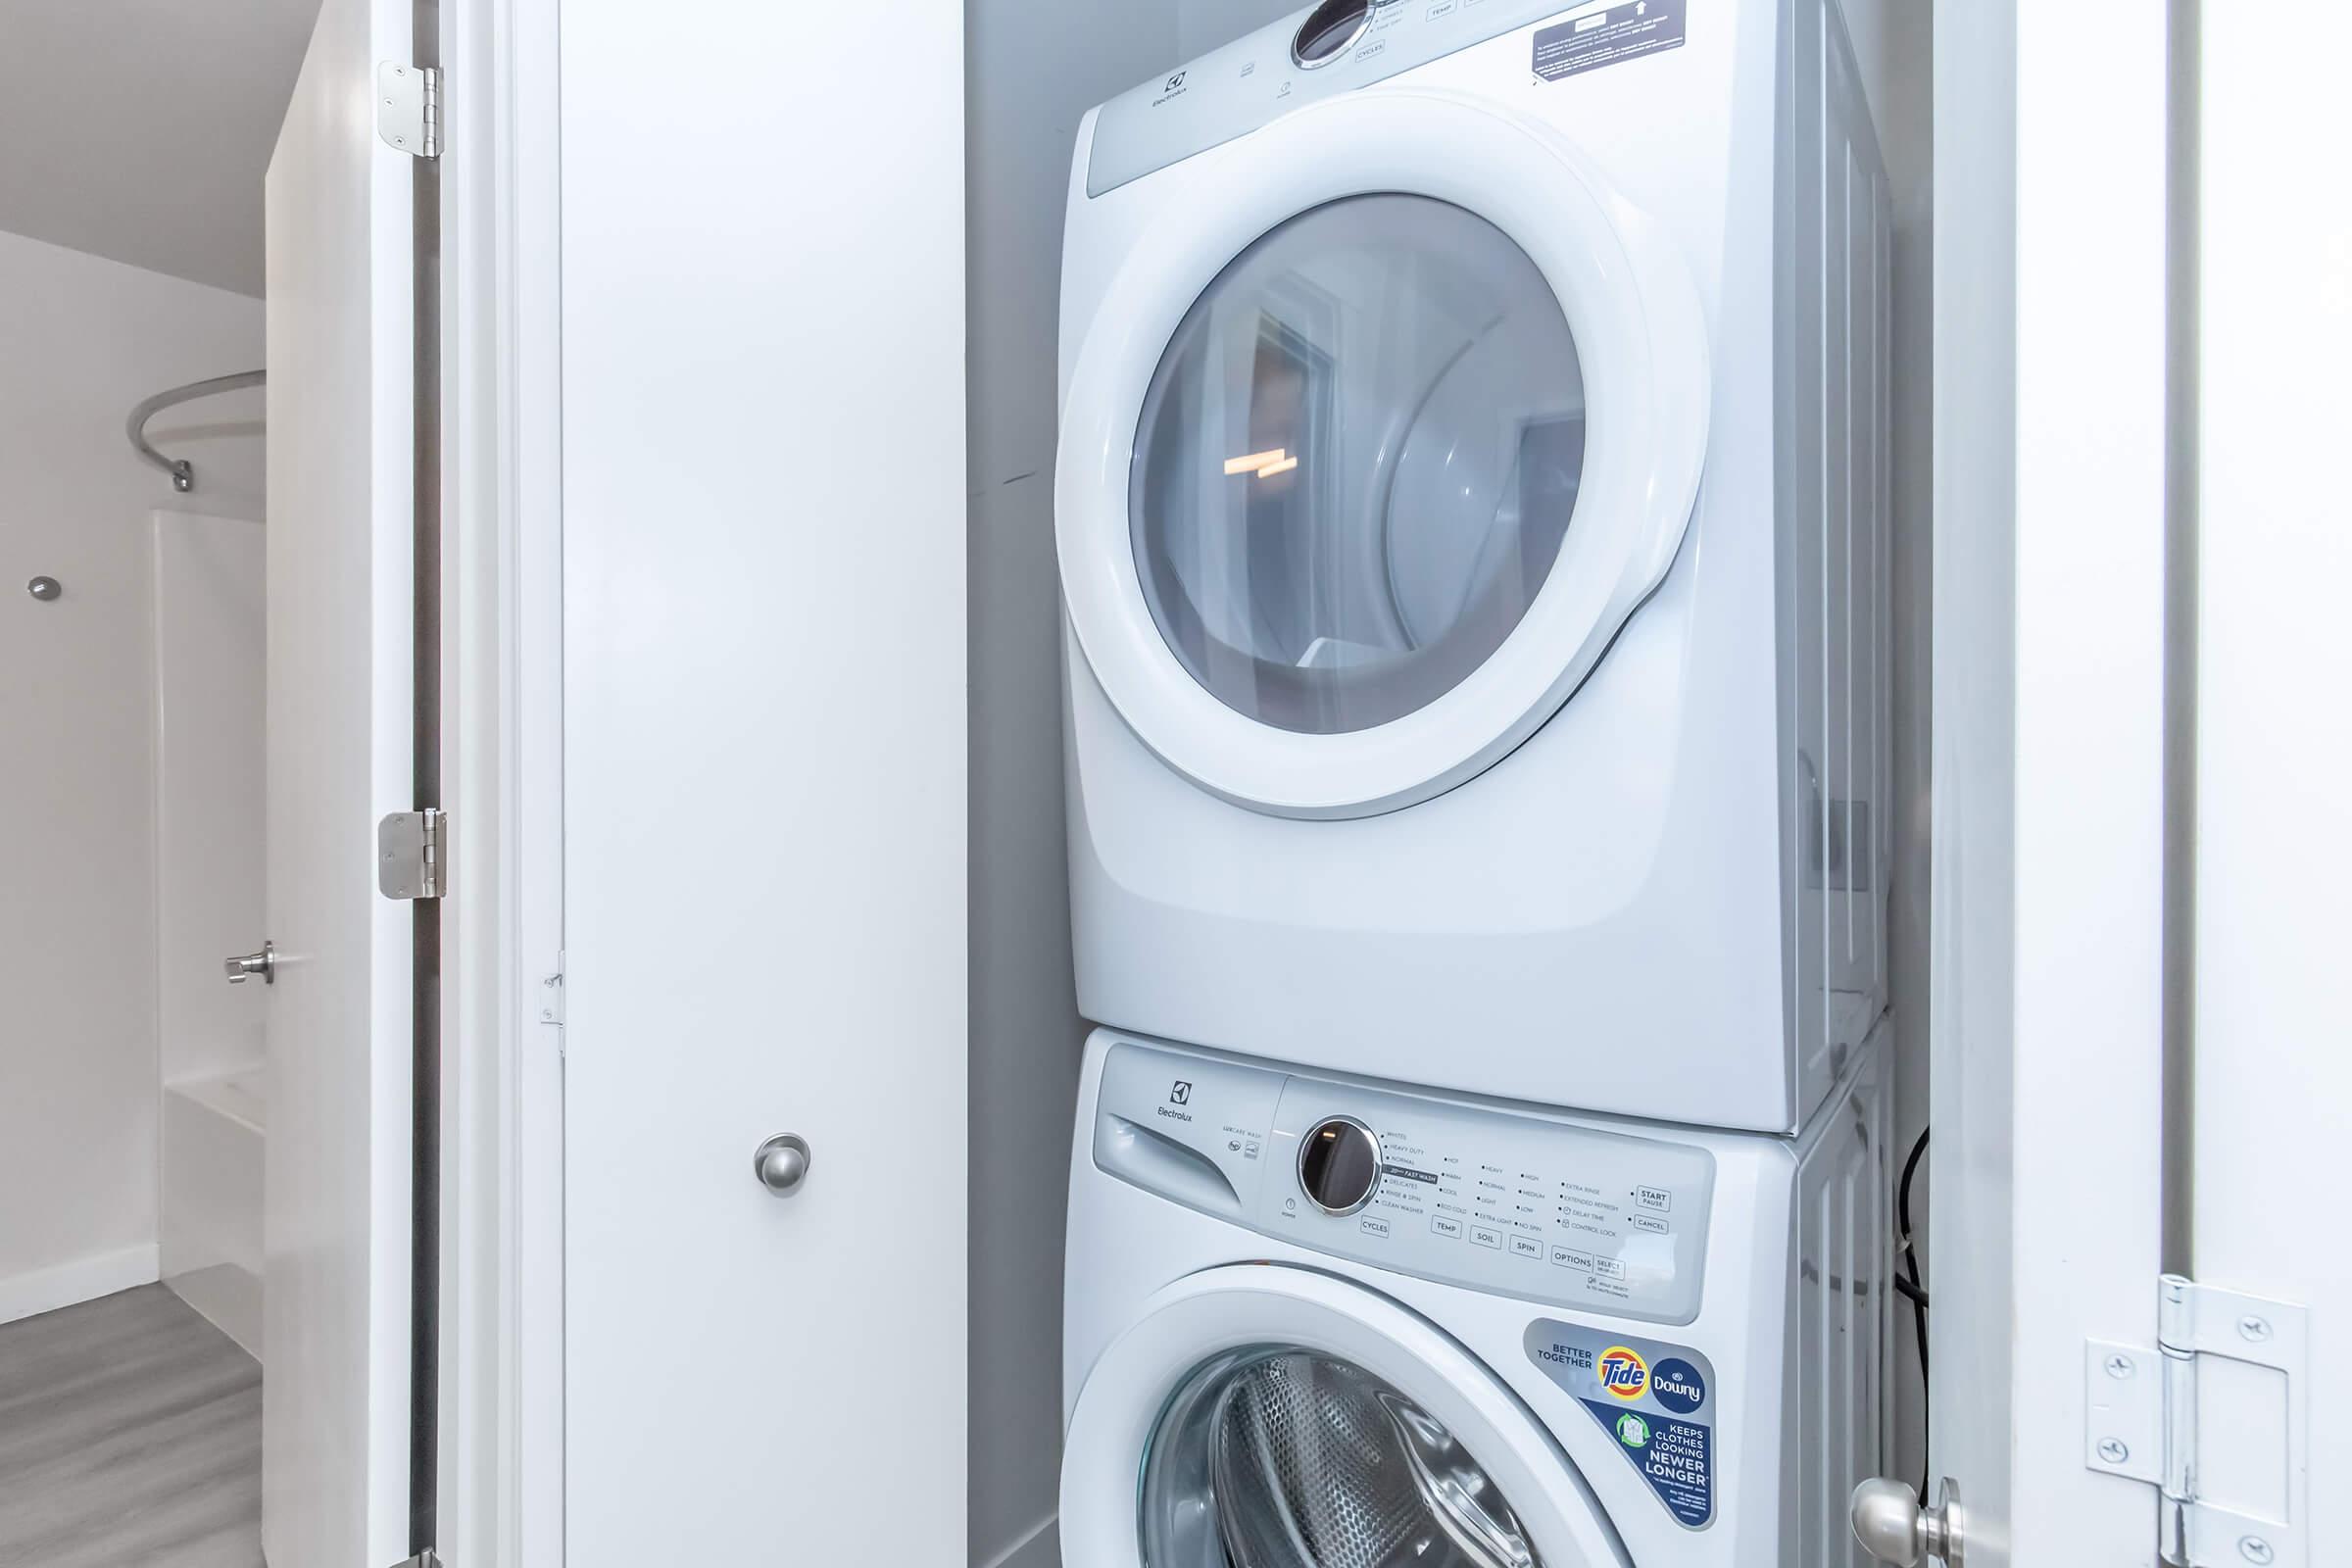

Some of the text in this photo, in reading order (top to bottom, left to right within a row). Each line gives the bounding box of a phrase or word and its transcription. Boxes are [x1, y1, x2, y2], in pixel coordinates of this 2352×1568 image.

[1357, 43, 1383, 58] CYCLES
[1152, 86, 1188, 107] Electrolux
[1157, 1106, 1193, 1122] Electrolux
[1391, 1155, 1414, 1165] NORMAL
[1486, 1165, 1503, 1174] HEAVY
[1389, 1180, 1417, 1190] DELICATES
[1484, 1181, 1506, 1192] NORMAL
[1566, 1183, 1584, 1192] EXTRA
[1523, 1190, 1545, 1199] MEDIUM
[1641, 1190, 1667, 1201] START
[1382, 1200, 1424, 1214] CLEAN WASHER
[1564, 1196, 1593, 1206] EXTENDED
[1642, 1198, 1663, 1207] PAUSE
[1573, 1209, 1590, 1218] DELAY
[1362, 1221, 1388, 1233] CYCLES
[1437, 1222, 1456, 1233] TEMP
[1571, 1222, 1616, 1237] CONTROL LOCK
[1638, 1219, 1664, 1231] CANCEL
[1477, 1232, 1494, 1243] SOIL
[1517, 1242, 1536, 1252] SPIN
[1554, 1252, 1592, 1268] OPTIONS
[1596, 1259, 1620, 1270] SELECT
[1552, 1344, 1592, 1359] BETTER
[1538, 1349, 1592, 1370] TOGETHER
[1601, 1358, 1645, 1388] Tide
[1654, 1376, 1700, 1402] Downy
[1670, 1424, 1703, 1440] KEEPS
[1655, 1431, 1703, 1449] CLOTHES
[1655, 1441, 1703, 1459] LOOKING
[1649, 1449, 1704, 1473] NEWER
[1645, 1461, 1706, 1487] LONGER
